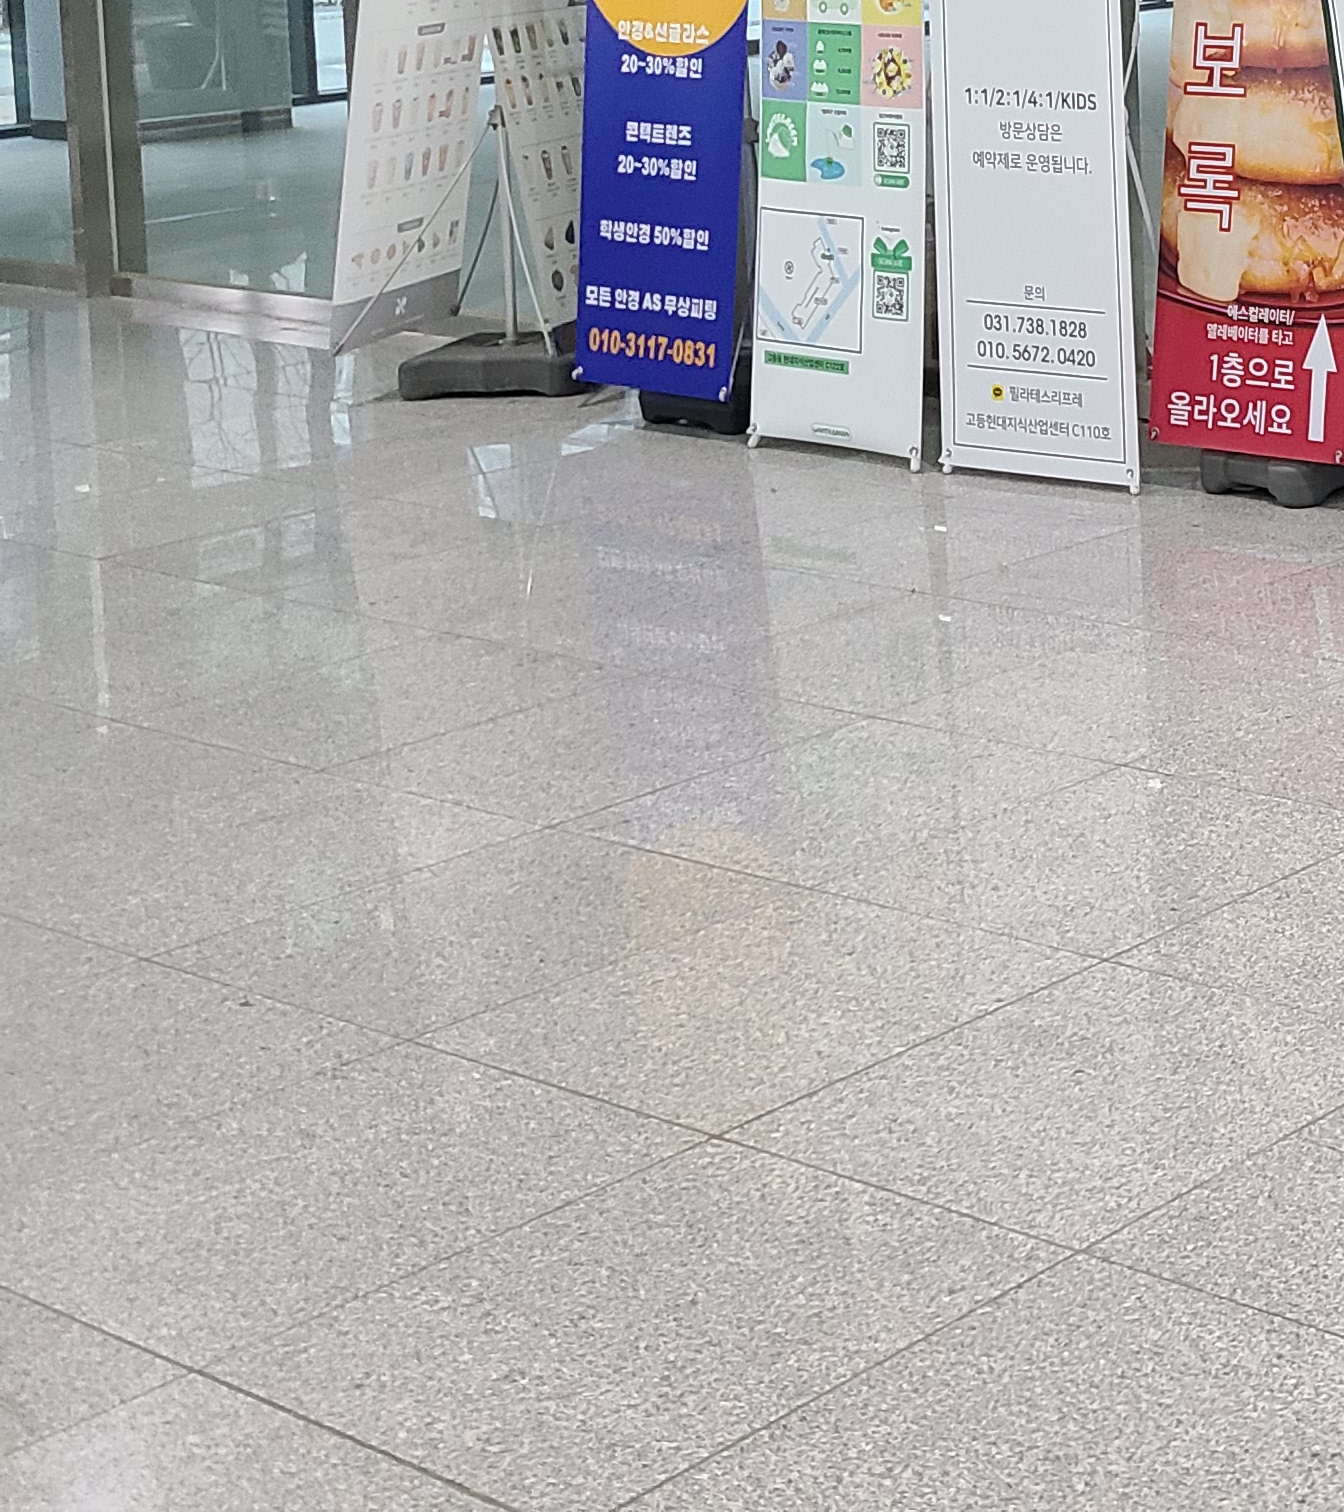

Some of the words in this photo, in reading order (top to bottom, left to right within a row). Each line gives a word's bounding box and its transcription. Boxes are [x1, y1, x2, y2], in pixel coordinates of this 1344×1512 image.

[617, 20, 710, 46] 안경&선글라스
[620, 54, 703, 79] 20~30%할인
[964, 87, 1097, 111] 1:1/2:1/4:1/KIDS
[999, 121, 1063, 142] 방문상담은
[617, 155, 697, 181] 20~30%할인
[972, 150, 1023, 171] 예약제로
[1025, 153, 1093, 176] 운영됩니다.
[600, 219, 651, 245] 학생안경
[653, 225, 710, 252] 50%할인
[585, 285, 612, 308] 모든
[614, 288, 640, 311] 안경
[642, 292, 662, 312] AS
[664, 295, 717, 321] 무상피팅
[1023, 285, 1045, 302] 문의
[984, 313, 1087, 339] 031.738.1828
[1227, 304, 1295, 326] 에스컬레이터/
[588, 326, 716, 369] 010-3117-0831
[1271, 329, 1294, 347] 타고
[1209, 352, 1295, 390] 1층으로
[1009, 385, 1083, 407] 필라테스리프레
[965, 412, 1070, 438] 고등현대지식산업센터
[1072, 424, 1112, 440] C110호
[1167, 391, 1293, 435] 올라오세요
